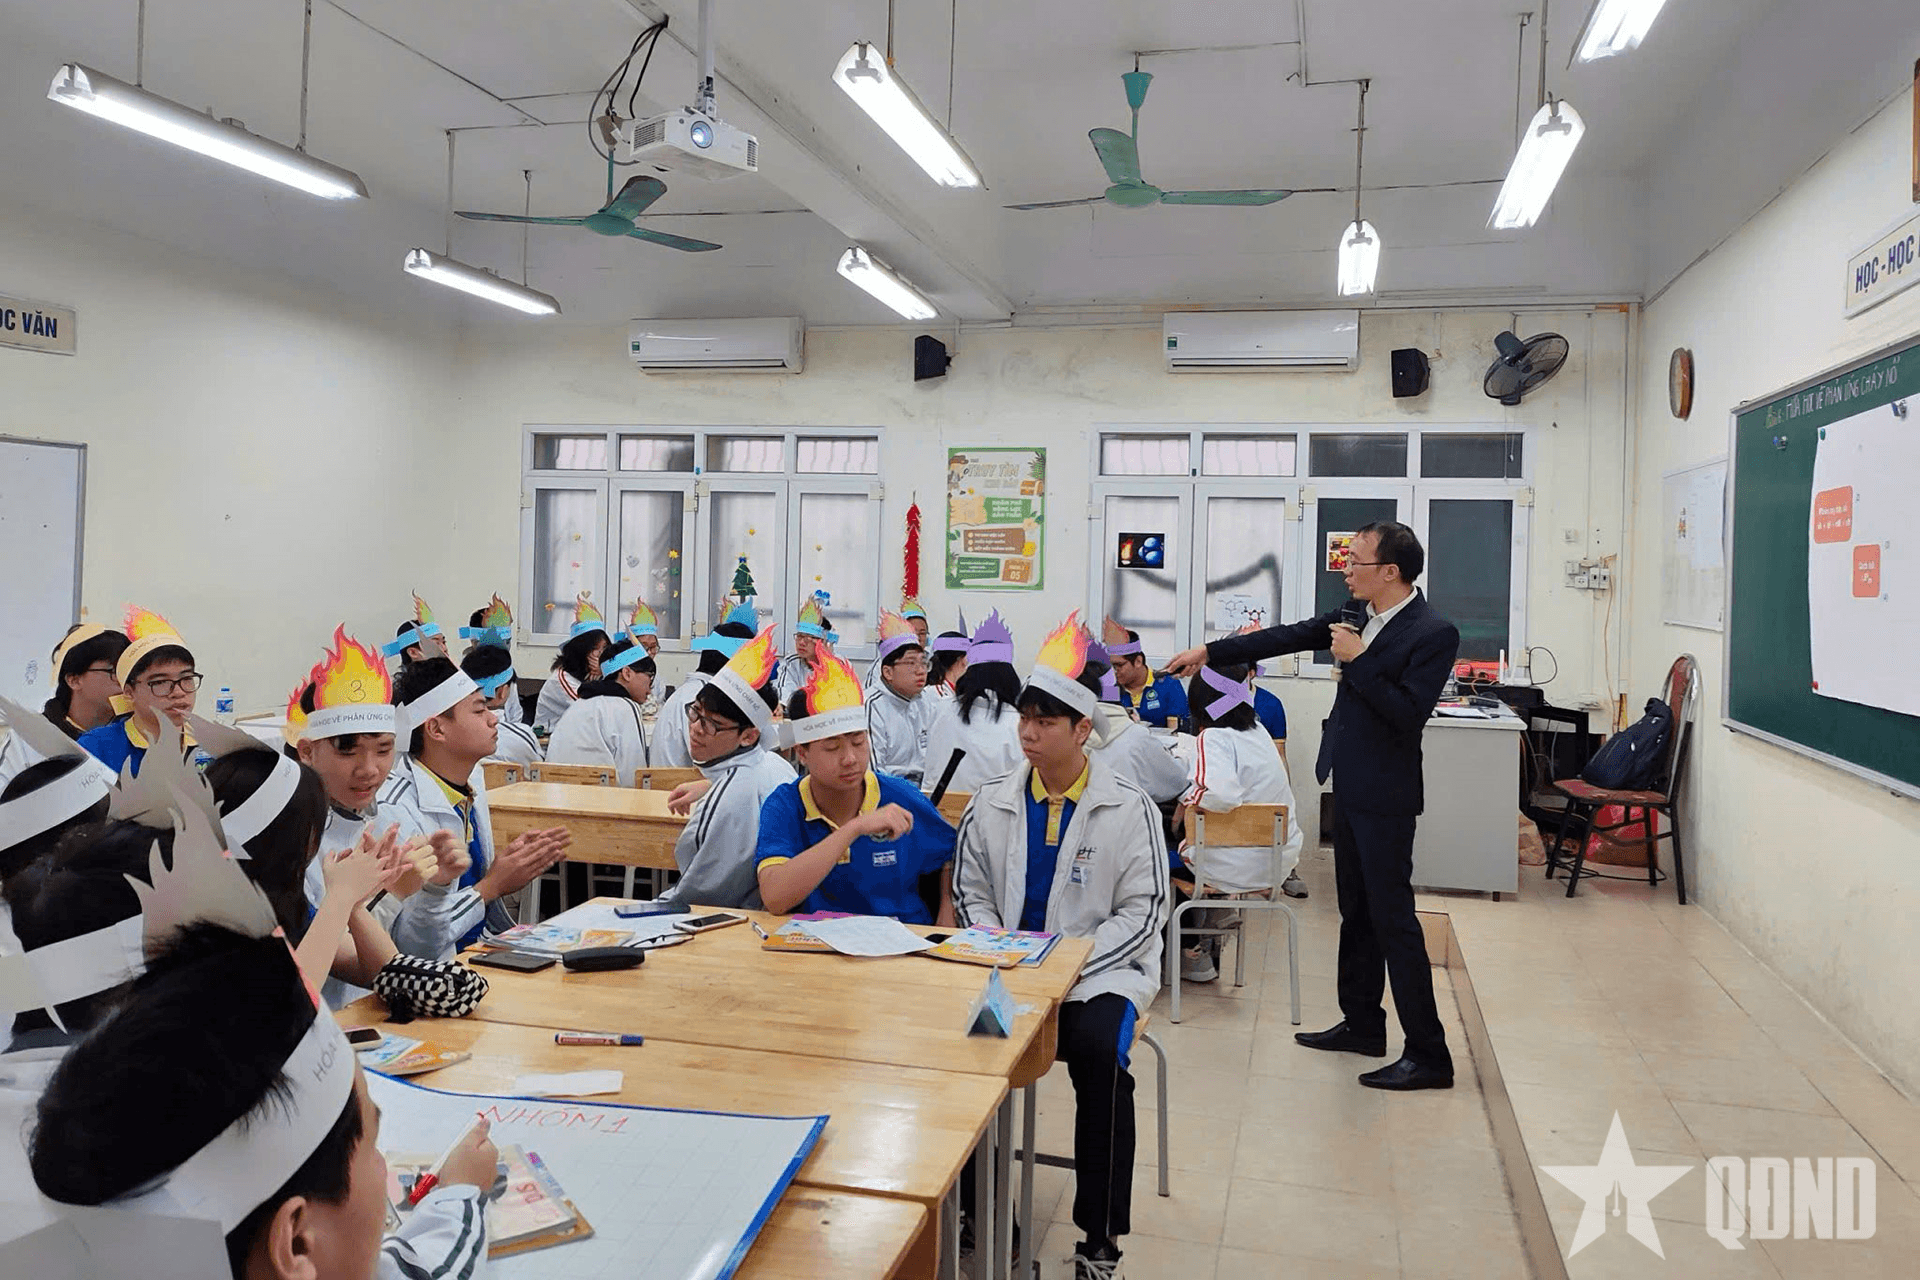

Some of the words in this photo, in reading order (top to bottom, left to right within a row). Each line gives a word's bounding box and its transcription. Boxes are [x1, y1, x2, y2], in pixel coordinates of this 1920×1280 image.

[1856, 257, 1879, 293] HỌC
[1888, 235, 1914, 275] HỌC
[22, 310, 57, 339] VĂN
[1861, 365, 1885, 396] CHÁY
[347, 680, 366, 702] 3
[342, 711, 365, 722] PHẢN
[366, 711, 383, 721] ỨNG
